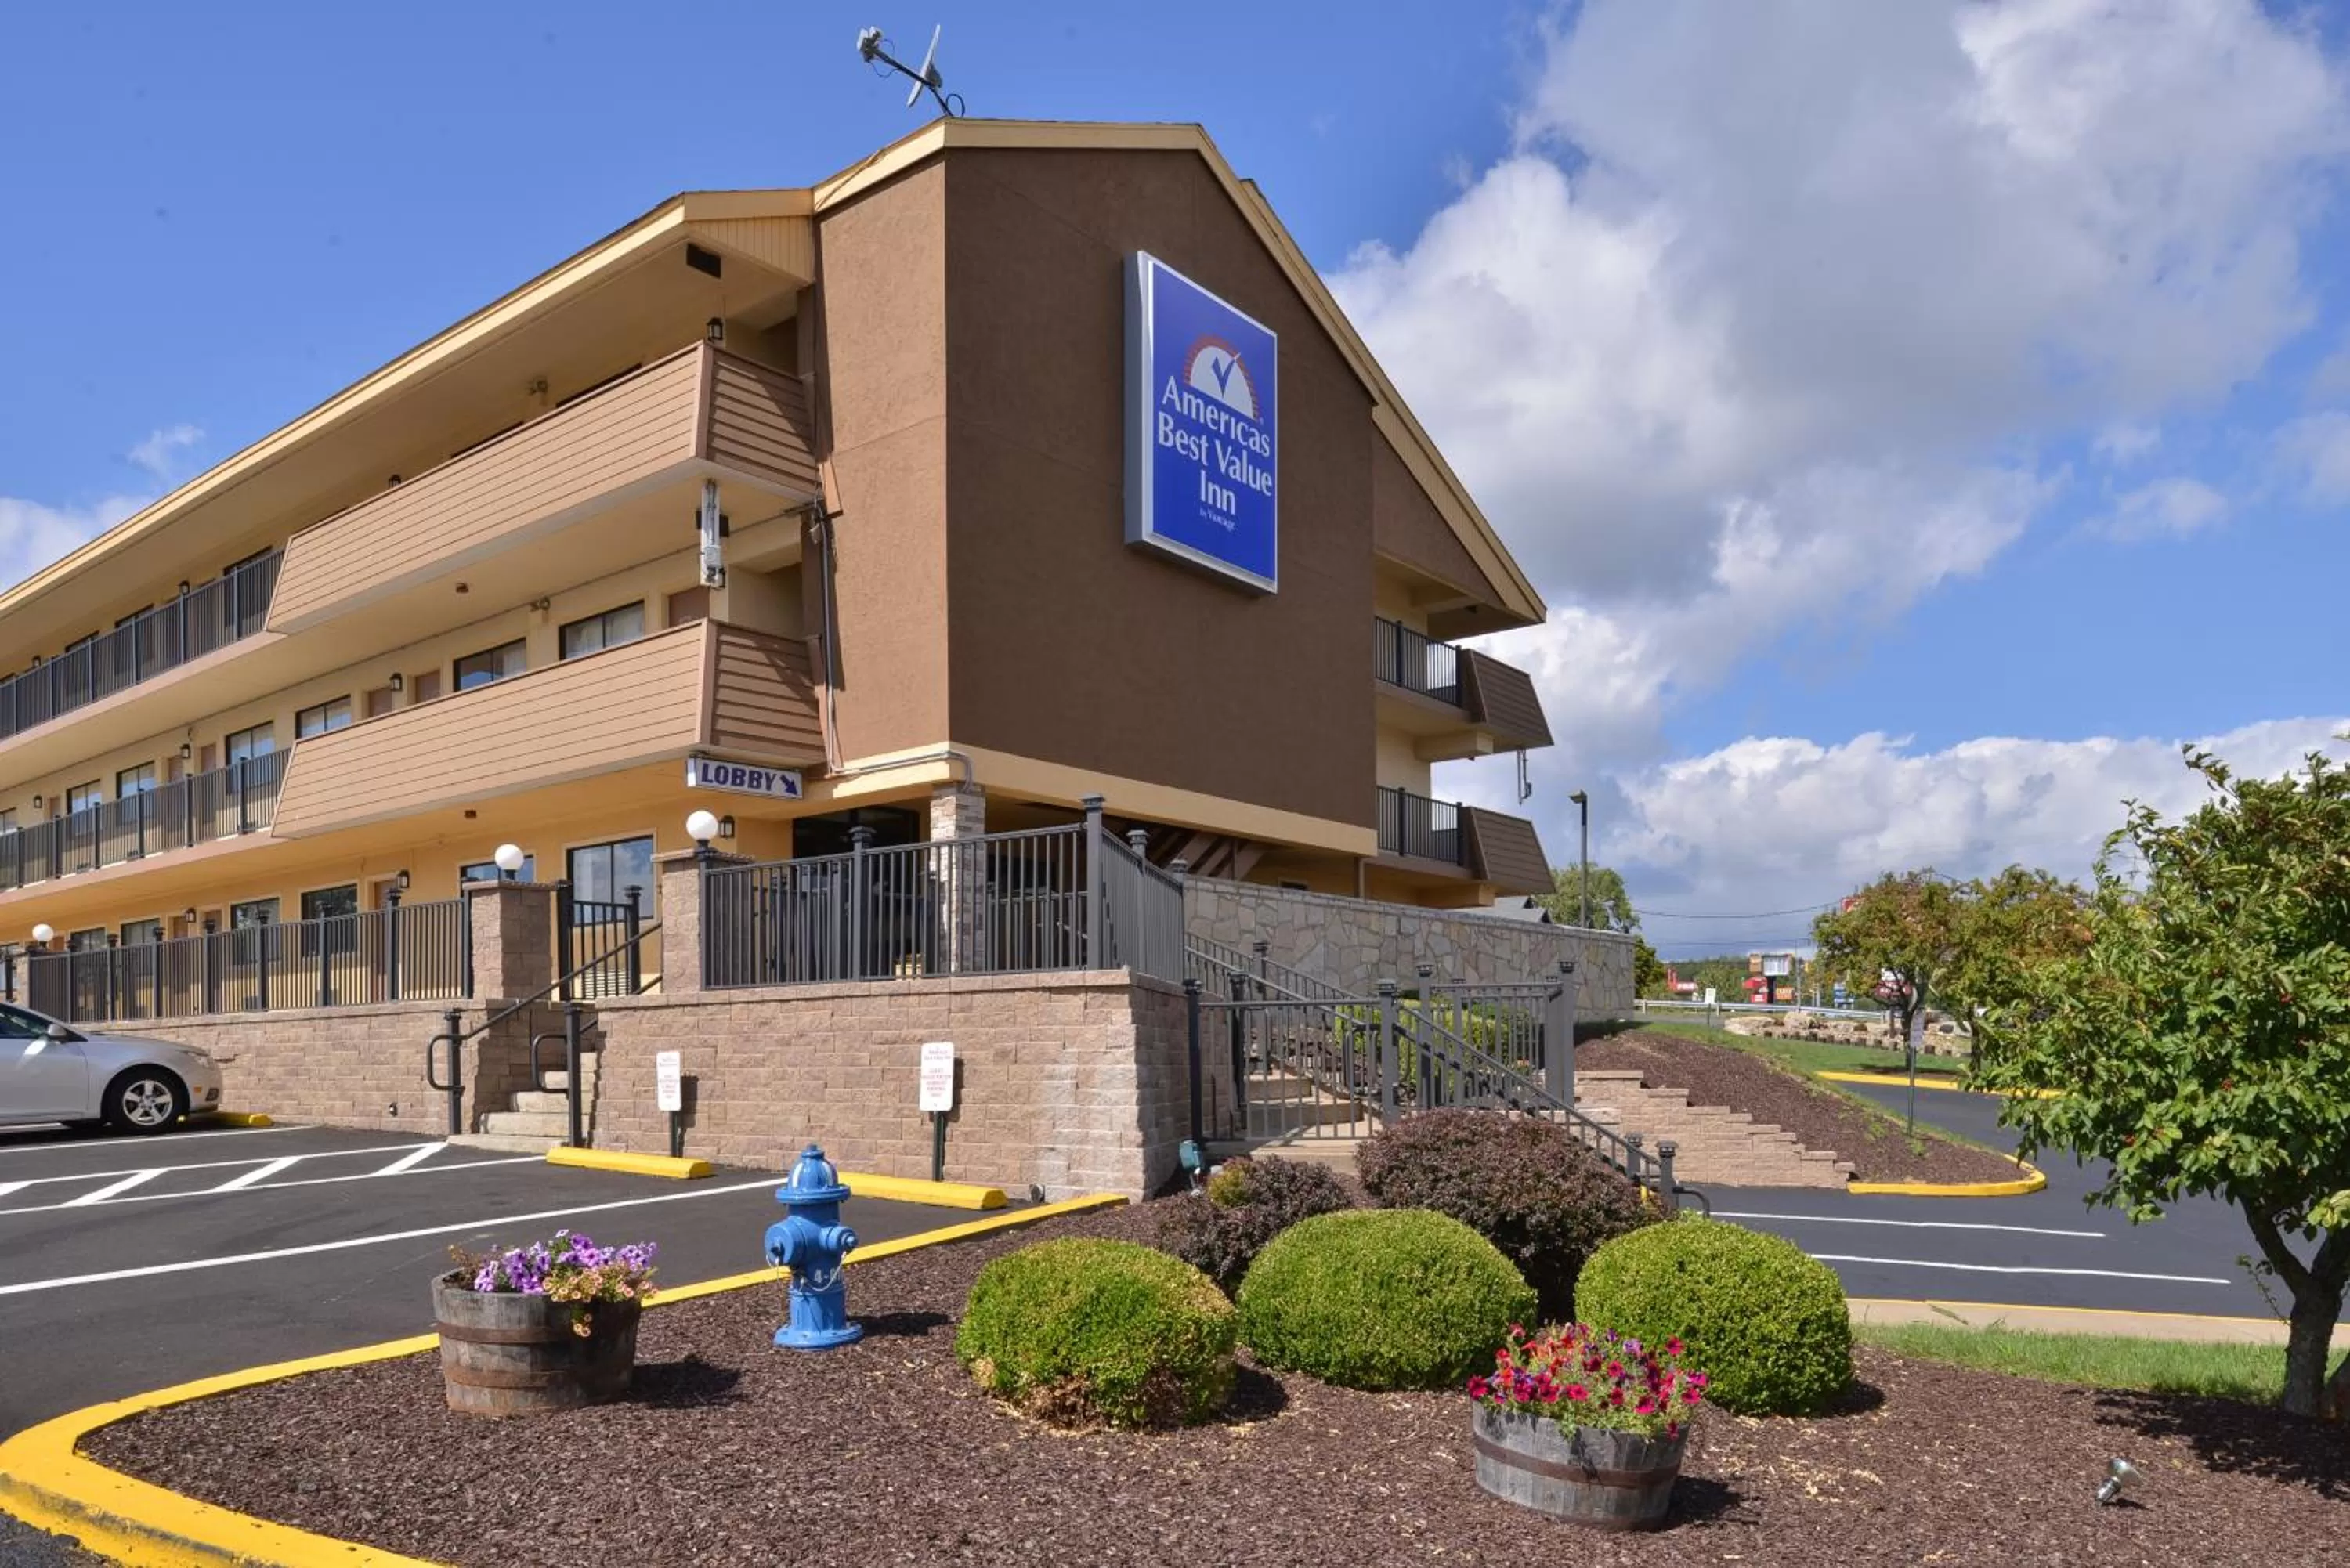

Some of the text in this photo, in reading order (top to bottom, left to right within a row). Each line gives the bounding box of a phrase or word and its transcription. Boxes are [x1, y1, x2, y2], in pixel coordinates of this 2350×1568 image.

[1162, 376, 1270, 457] Americas
[1159, 411, 1272, 496] Best Value
[1200, 469, 1235, 515] Inn
[701, 764, 777, 791] LOBBY
